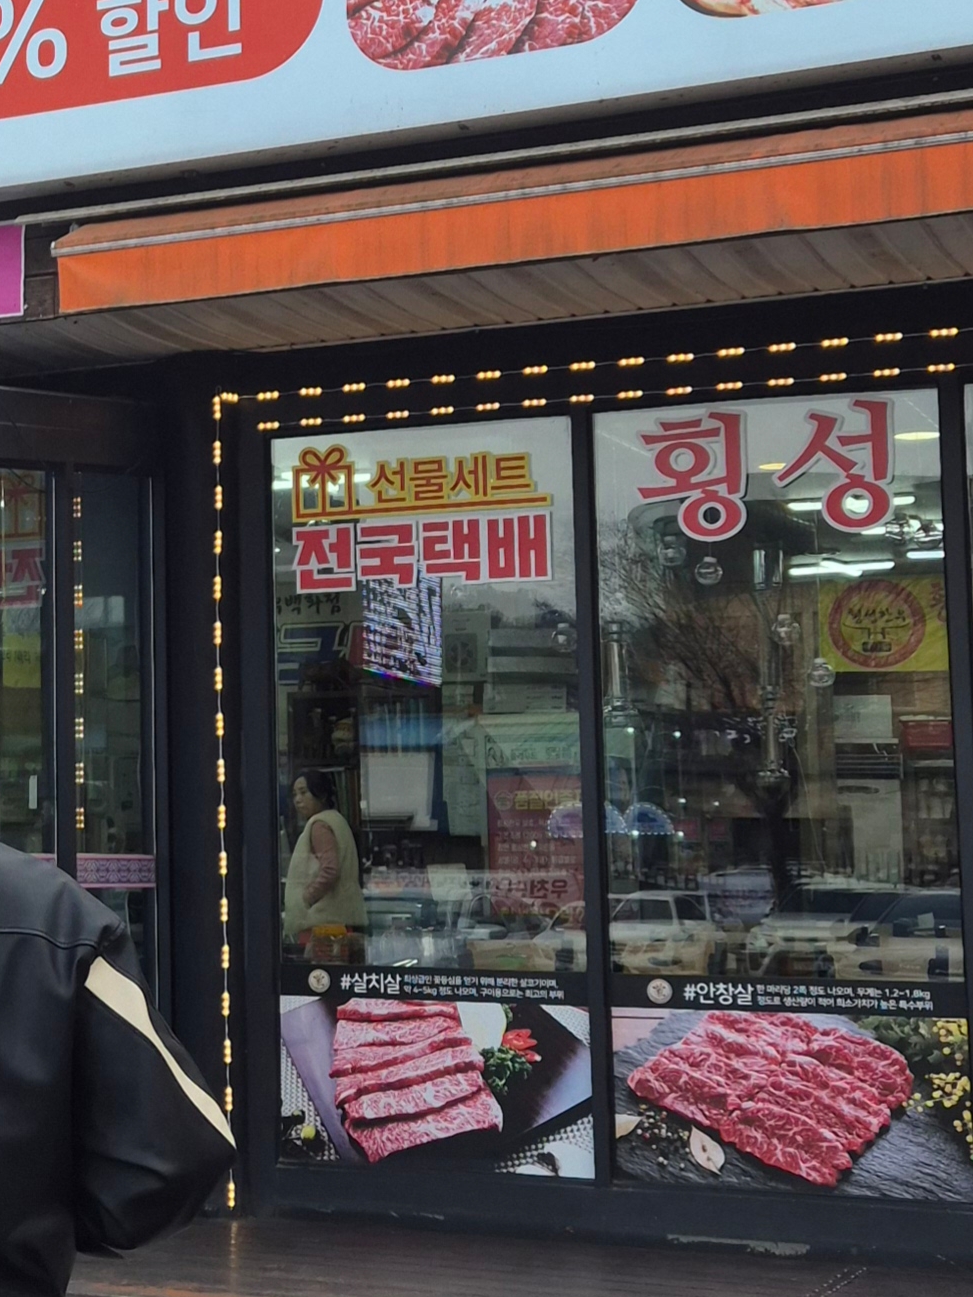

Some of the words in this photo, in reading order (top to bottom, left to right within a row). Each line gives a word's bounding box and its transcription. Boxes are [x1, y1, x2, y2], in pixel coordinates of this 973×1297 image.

[96, 0, 243, 77] 할인
[367, 452, 534, 503] 선물세트
[636, 398, 892, 540] 횡성
[293, 511, 552, 593] 전국택배
[340, 972, 402, 994] #살치살
[683, 982, 755, 1005] #안창살
